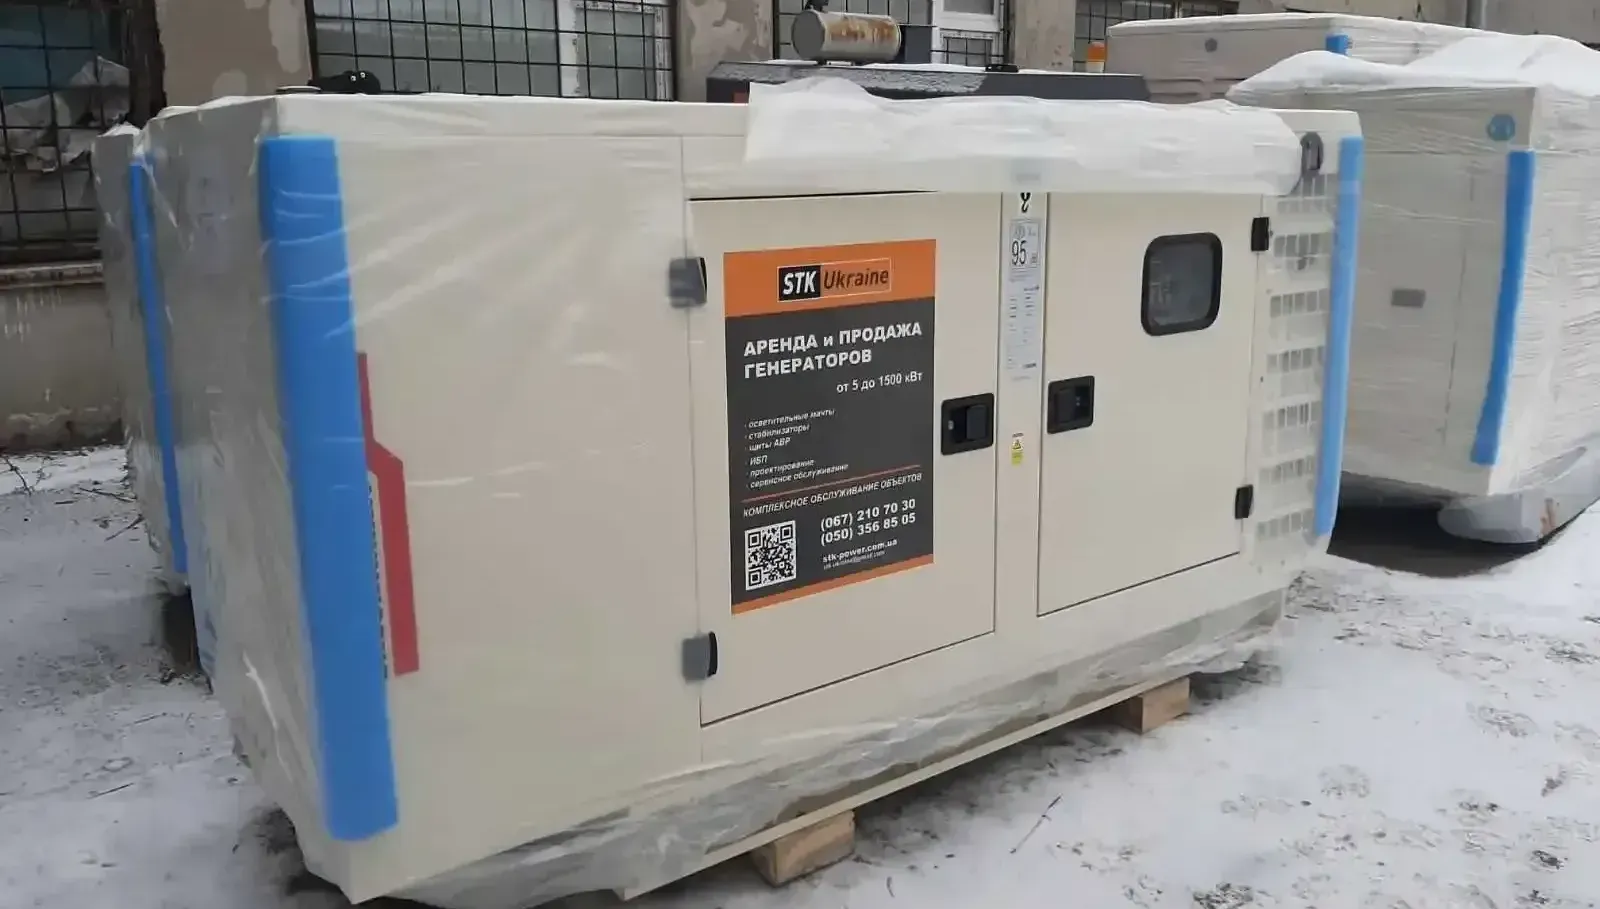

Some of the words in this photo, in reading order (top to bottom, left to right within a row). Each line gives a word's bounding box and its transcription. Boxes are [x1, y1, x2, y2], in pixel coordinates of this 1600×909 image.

[1011, 240, 1027, 265] 95
[783, 270, 816, 296] STK
[823, 268, 889, 290] Ukraine
[744, 335, 818, 357] АРЕНДА
[824, 336, 833, 347] и
[839, 322, 922, 345] ПРОДАЖА
[744, 349, 872, 379] ГЕНЕРАТОРОВ
[836, 382, 849, 393] от
[852, 380, 859, 390] 5
[861, 379, 876, 392] до
[879, 373, 902, 387] 1500
[905, 371, 924, 383] кВт
[743, 496, 810, 517] КОМПЛЕКСНОЕ
[811, 481, 879, 503] ОБСЛУЖИВАНИЕ
[880, 473, 922, 488] ОБЪЕКТОВ
[820, 513, 853, 532] (067)
[857, 507, 880, 522] 210
[884, 504, 898, 515] 70
[902, 498, 916, 511] 30
[820, 527, 853, 546] (050)
[857, 521, 880, 536] 356
[884, 518, 898, 530] 85
[902, 512, 916, 525] 05
[823, 539, 898, 563] stk-power.com.ua
